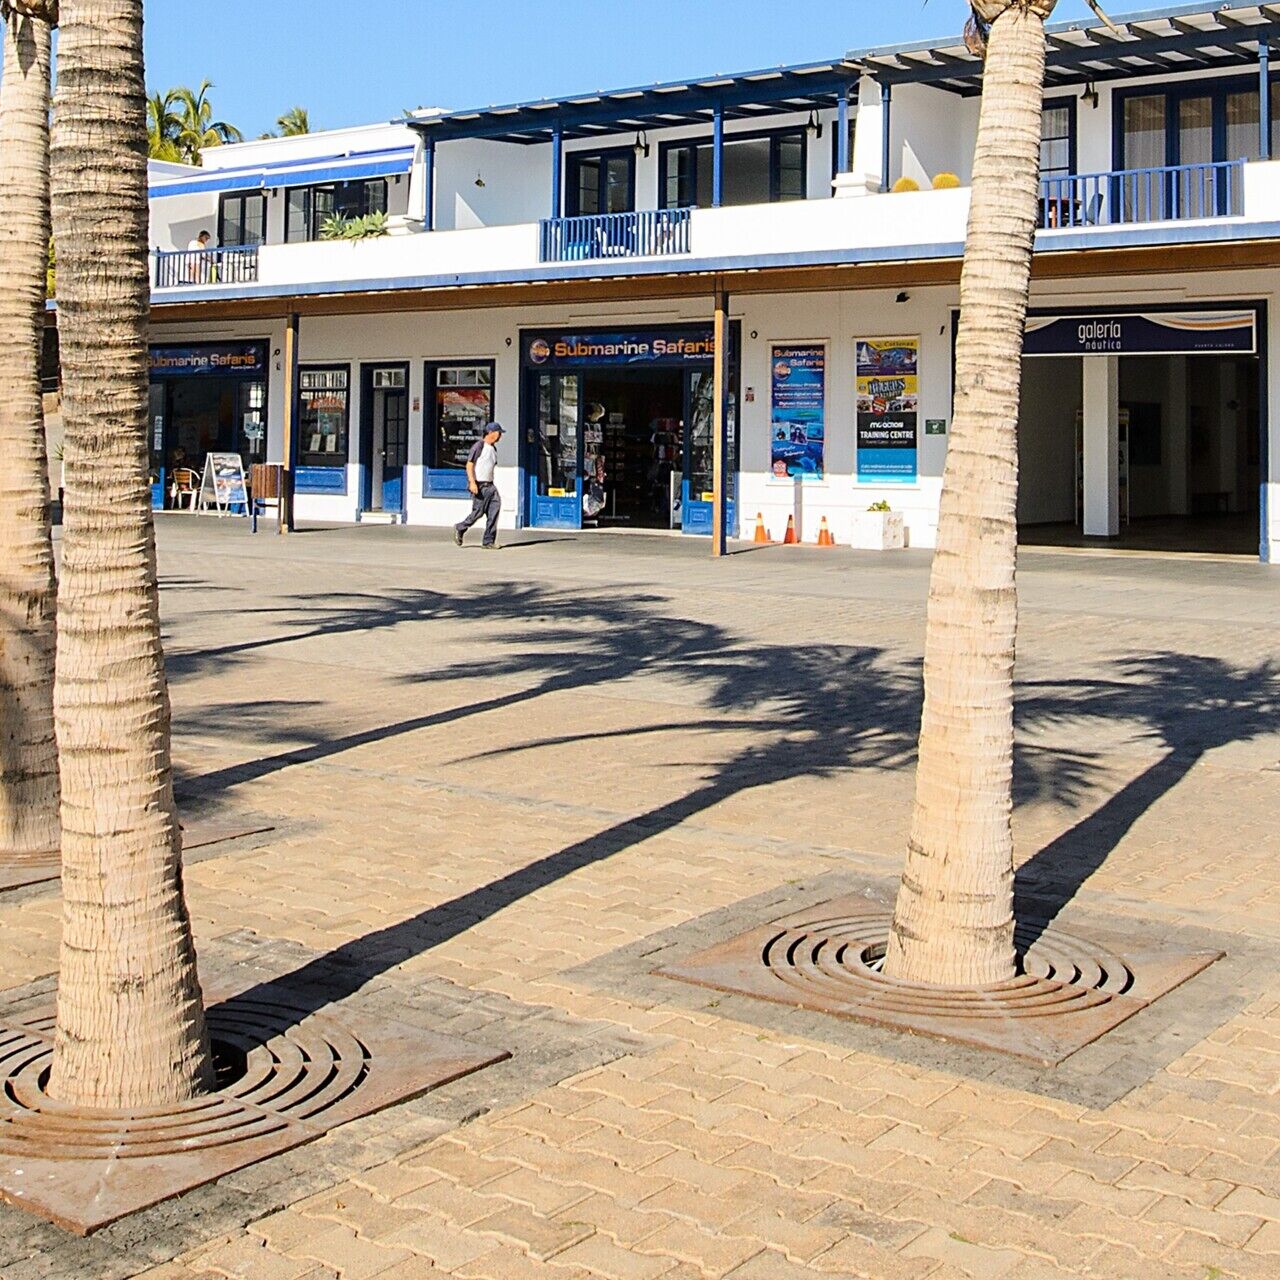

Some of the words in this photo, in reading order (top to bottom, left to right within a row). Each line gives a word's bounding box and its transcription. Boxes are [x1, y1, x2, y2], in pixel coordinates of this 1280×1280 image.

[1078, 320, 1121, 344] galería
[554, 340, 649, 357] Submarine
[1085, 338, 1121, 350] náutica
[773, 349, 824, 357] Submarine
[210, 353, 255, 366] Safaris
[789, 358, 824, 367] Safaris
[859, 430, 889, 439] TRAINING
[890, 430, 914, 439] CENTRE
